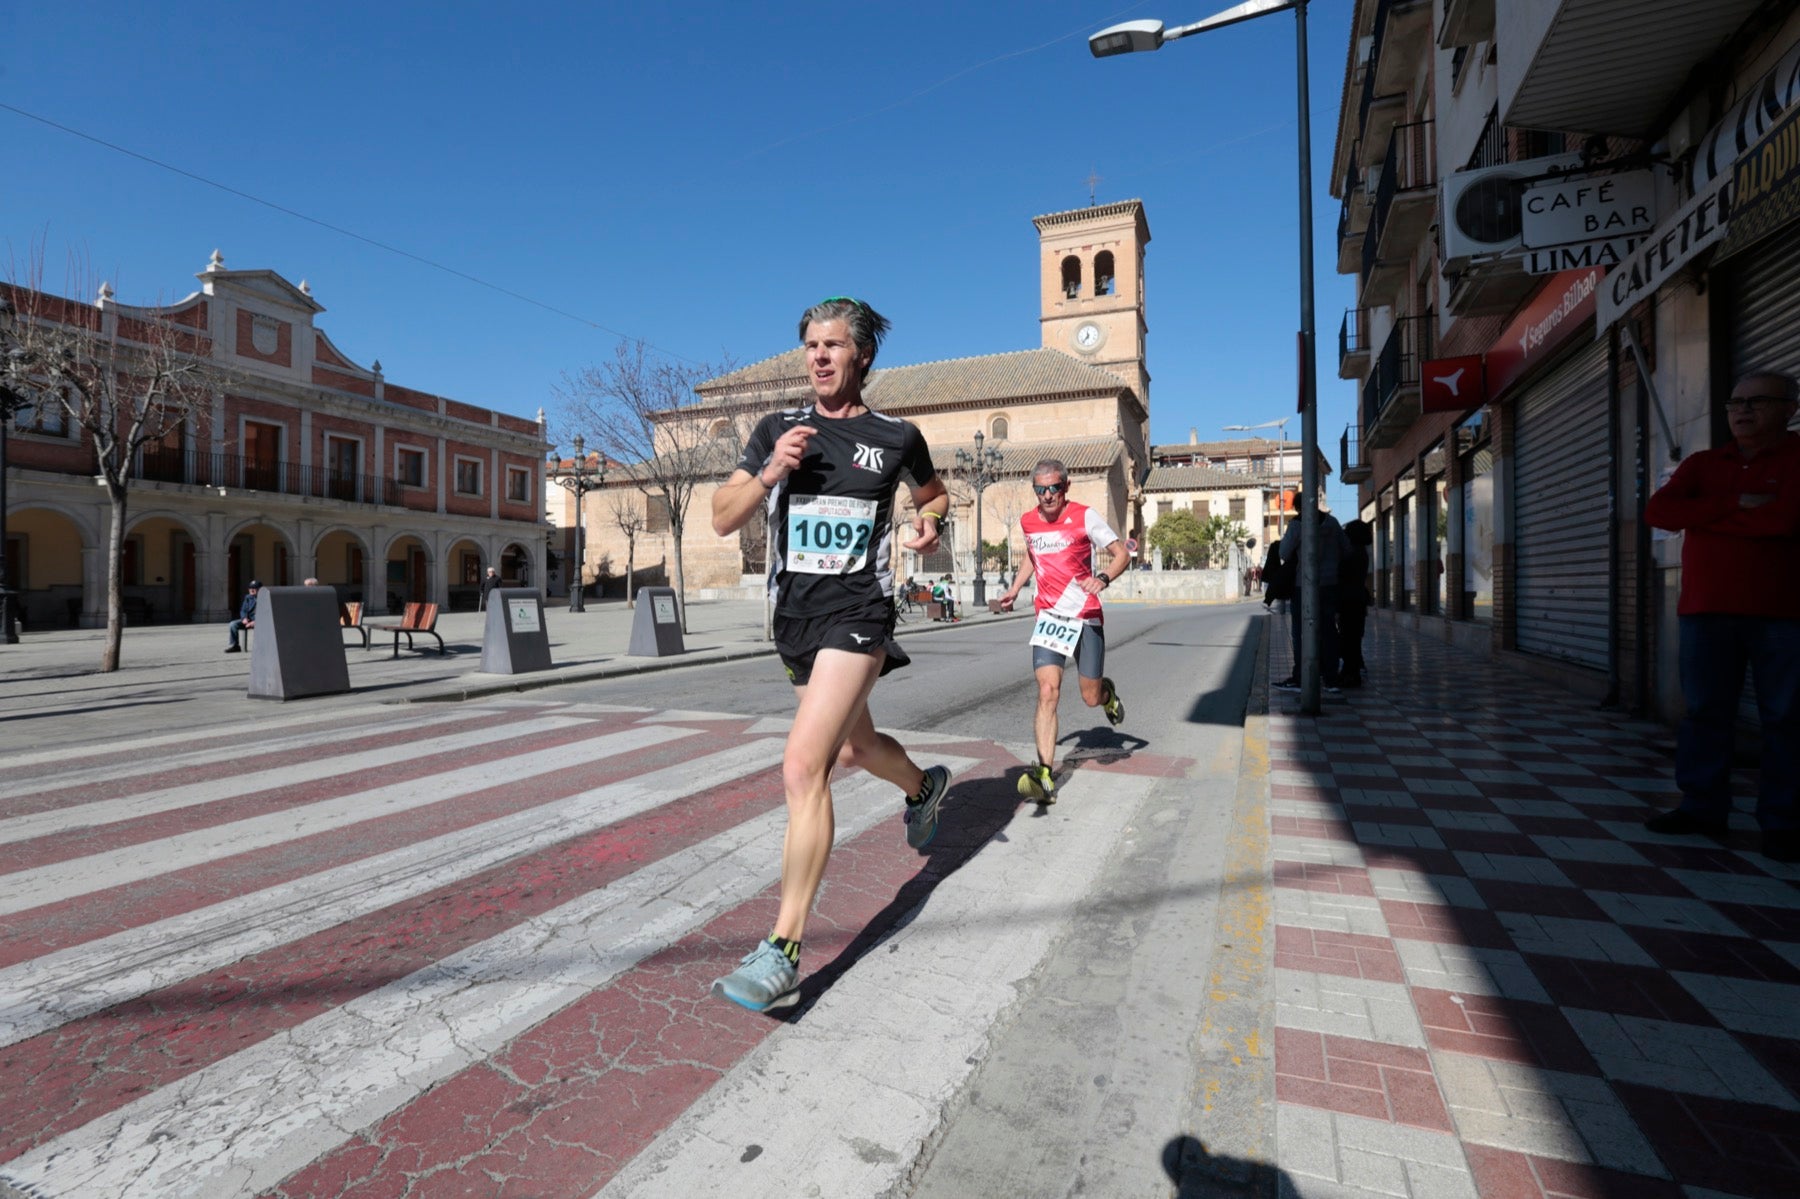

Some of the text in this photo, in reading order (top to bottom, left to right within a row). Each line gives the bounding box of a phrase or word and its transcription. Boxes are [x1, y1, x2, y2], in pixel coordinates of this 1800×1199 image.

[1735, 113, 1800, 211] ALQUI
[1527, 180, 1614, 214] CAFÉ
[1585, 206, 1649, 232] BAR
[1528, 270, 1597, 350] Seguros Bilbao
[795, 519, 870, 551] 1092
